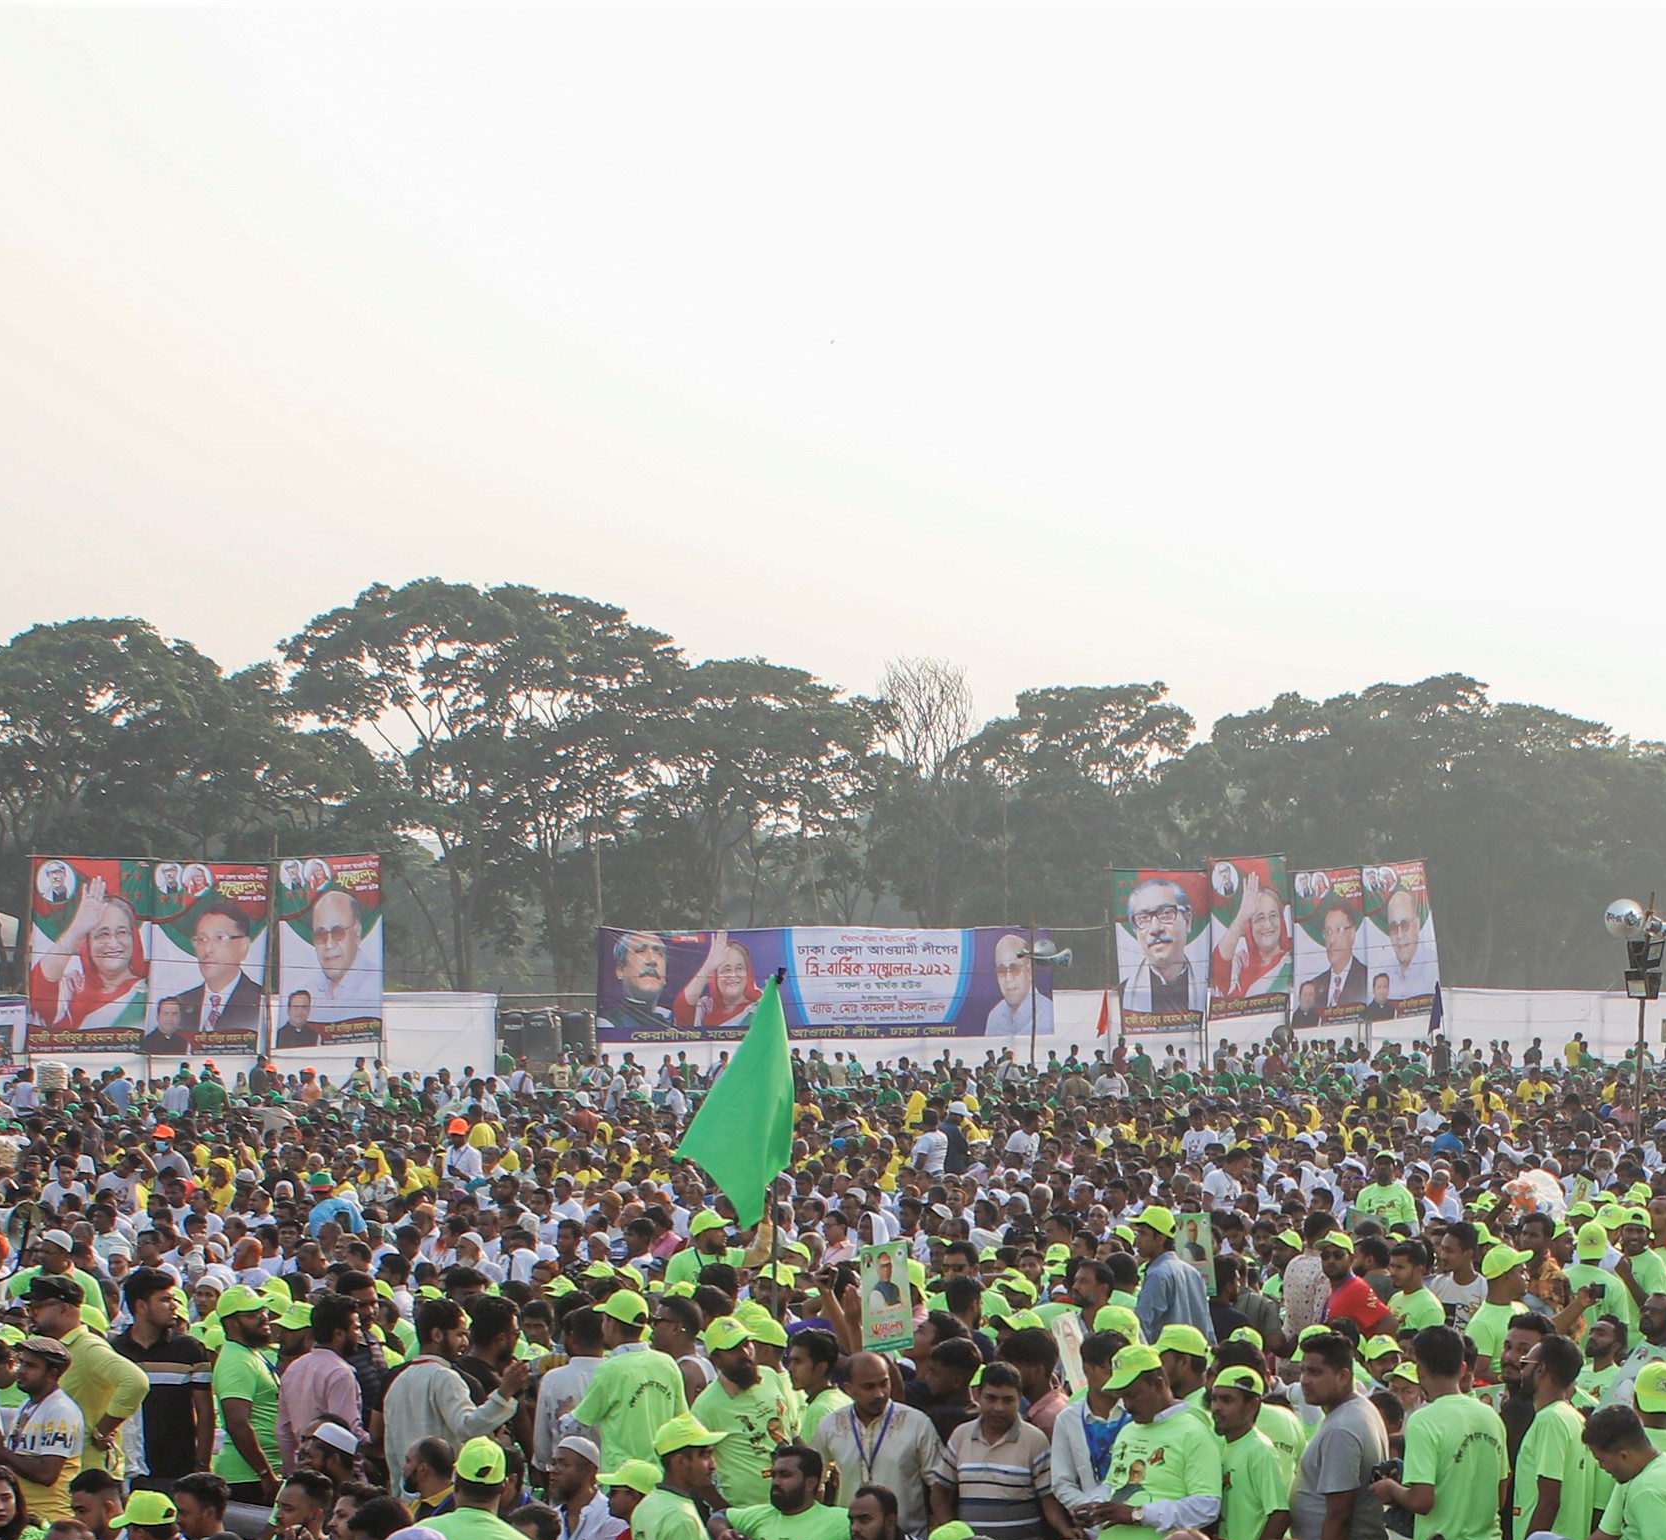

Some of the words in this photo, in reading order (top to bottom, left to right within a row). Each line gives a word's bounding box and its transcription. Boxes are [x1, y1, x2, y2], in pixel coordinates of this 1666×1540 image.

[797, 945, 825, 956] ঢাকা
[831, 945, 862, 956] জেলা
[868, 942, 918, 956] আওয়ামী
[922, 941, 959, 955] লীগের
[805, 957, 864, 977] ত্রি-বার্ষিক
[868, 960, 952, 980] সম্মেলন-২০২২
[836, 982, 860, 991] সফল
[864, 982, 872, 990] ও
[899, 1001, 926, 1013] ইসলাম
[790, 1026, 849, 1038] আওয়ামী
[890, 1027, 917, 1036] ঢাকা
[922, 1025, 957, 1036] জেলা
